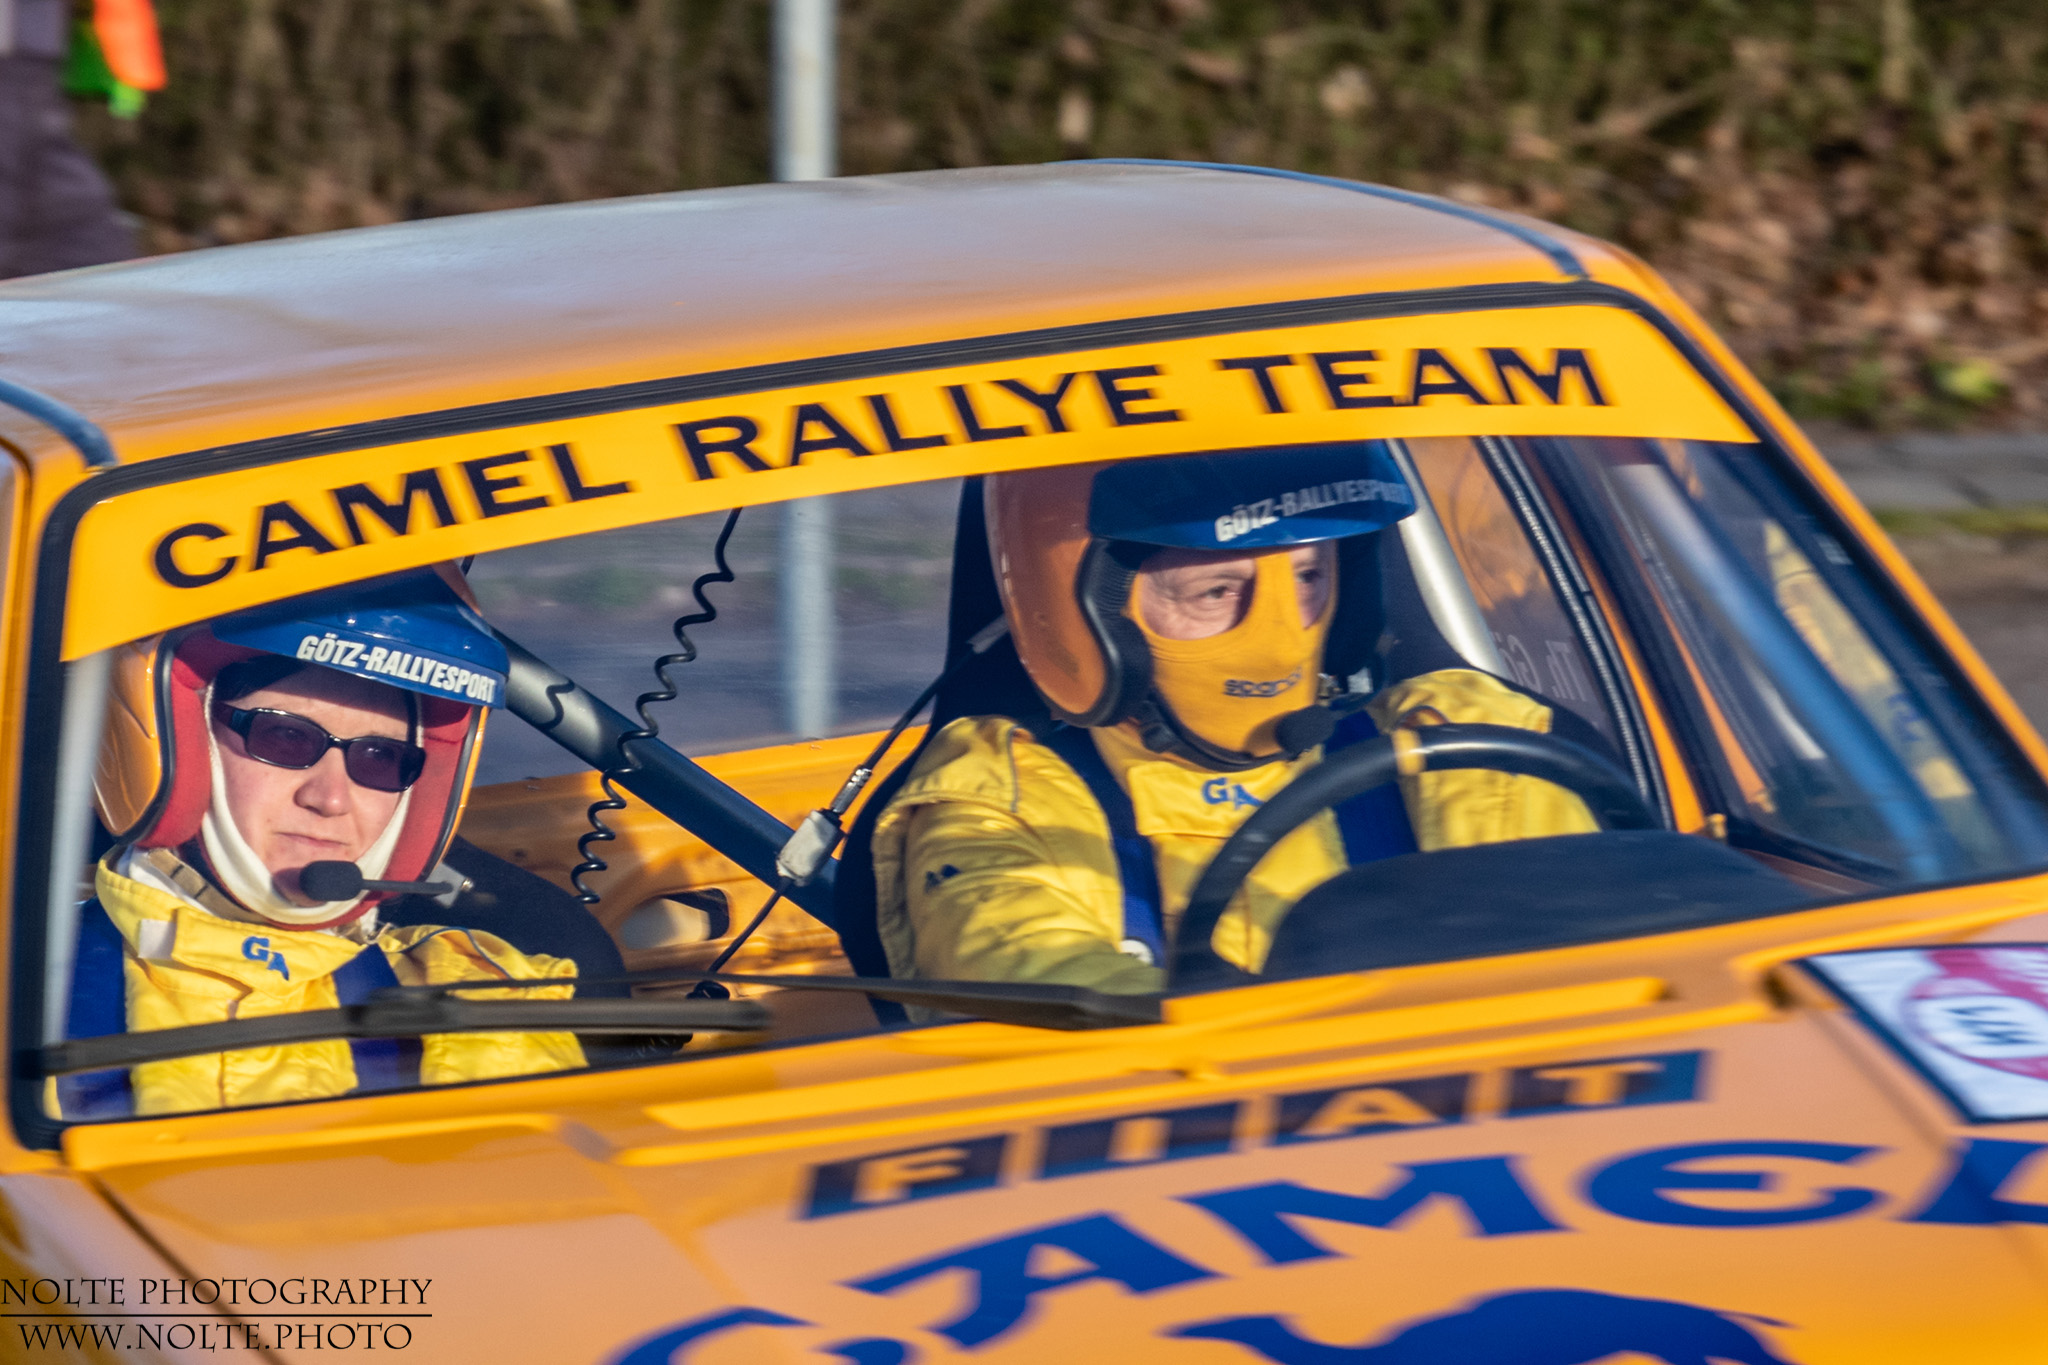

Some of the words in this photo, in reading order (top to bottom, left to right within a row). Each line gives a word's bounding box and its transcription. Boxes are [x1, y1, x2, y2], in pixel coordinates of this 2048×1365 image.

[151, 443, 633, 590] CAMEL
[672, 365, 1184, 482] RALLYE
[1216, 347, 1612, 415] TEAM
[296, 632, 497, 703] GÖTZ-RALLYESPORT
[843, 1060, 1665, 1204] FIAT
